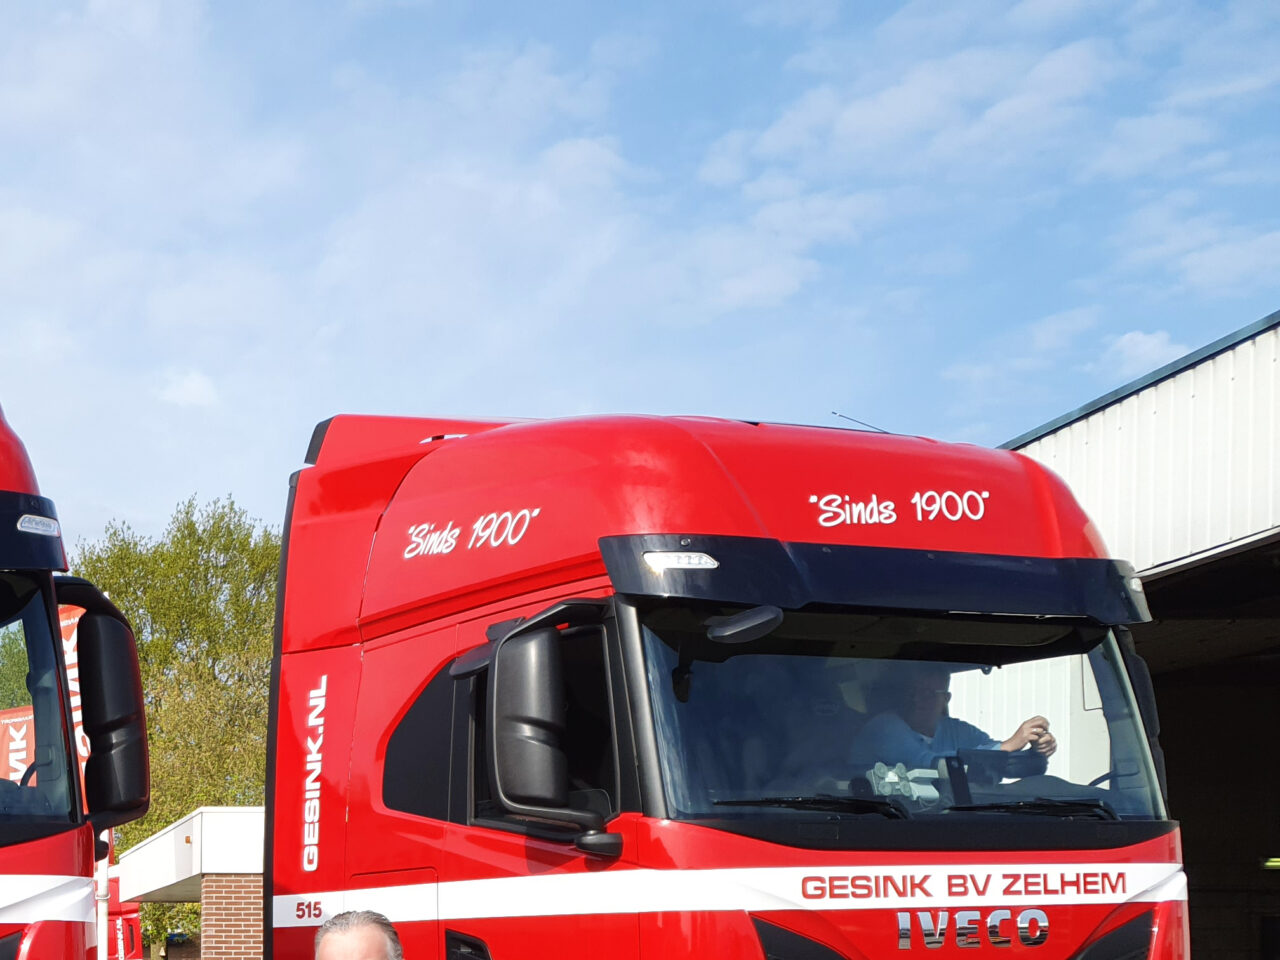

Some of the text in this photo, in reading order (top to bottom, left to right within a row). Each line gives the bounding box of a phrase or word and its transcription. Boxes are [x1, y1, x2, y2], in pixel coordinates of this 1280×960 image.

[303, 674, 328, 872] GESINK.NL
[802, 872, 1127, 899] GESINK BV ZELHEM
[295, 901, 323, 919] 515
[896, 909, 1050, 950] IVECO
